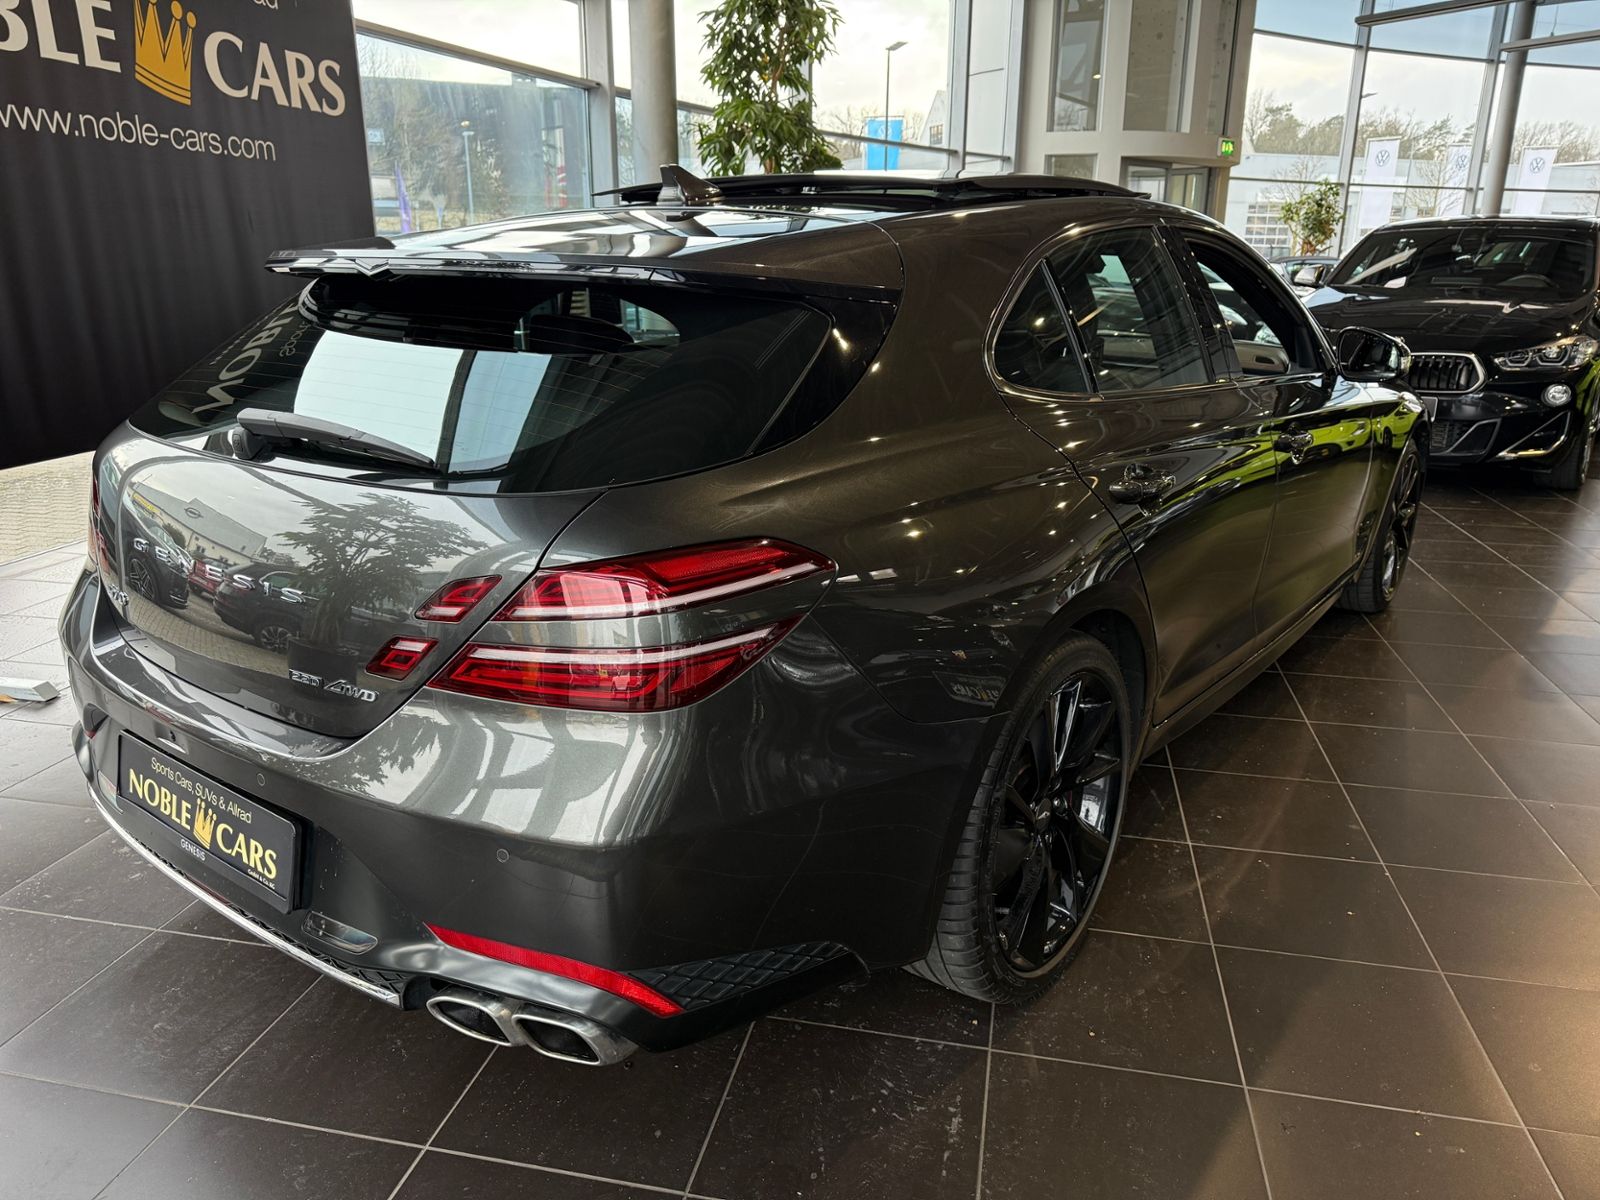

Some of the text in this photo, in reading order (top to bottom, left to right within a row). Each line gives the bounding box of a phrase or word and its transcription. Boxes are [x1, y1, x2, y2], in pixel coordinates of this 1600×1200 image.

[203, 31, 346, 117] CARS
[133, 537, 306, 604] GENESIS
[323, 679, 380, 702] AWD
[129, 768, 277, 880] NOBLE CARS
[151, 757, 175, 781] Sports
[195, 782, 218, 806] SUVs
[218, 796, 226, 811] &
[226, 801, 252, 824] Allrad
[180, 838, 206, 861] GENESIS
